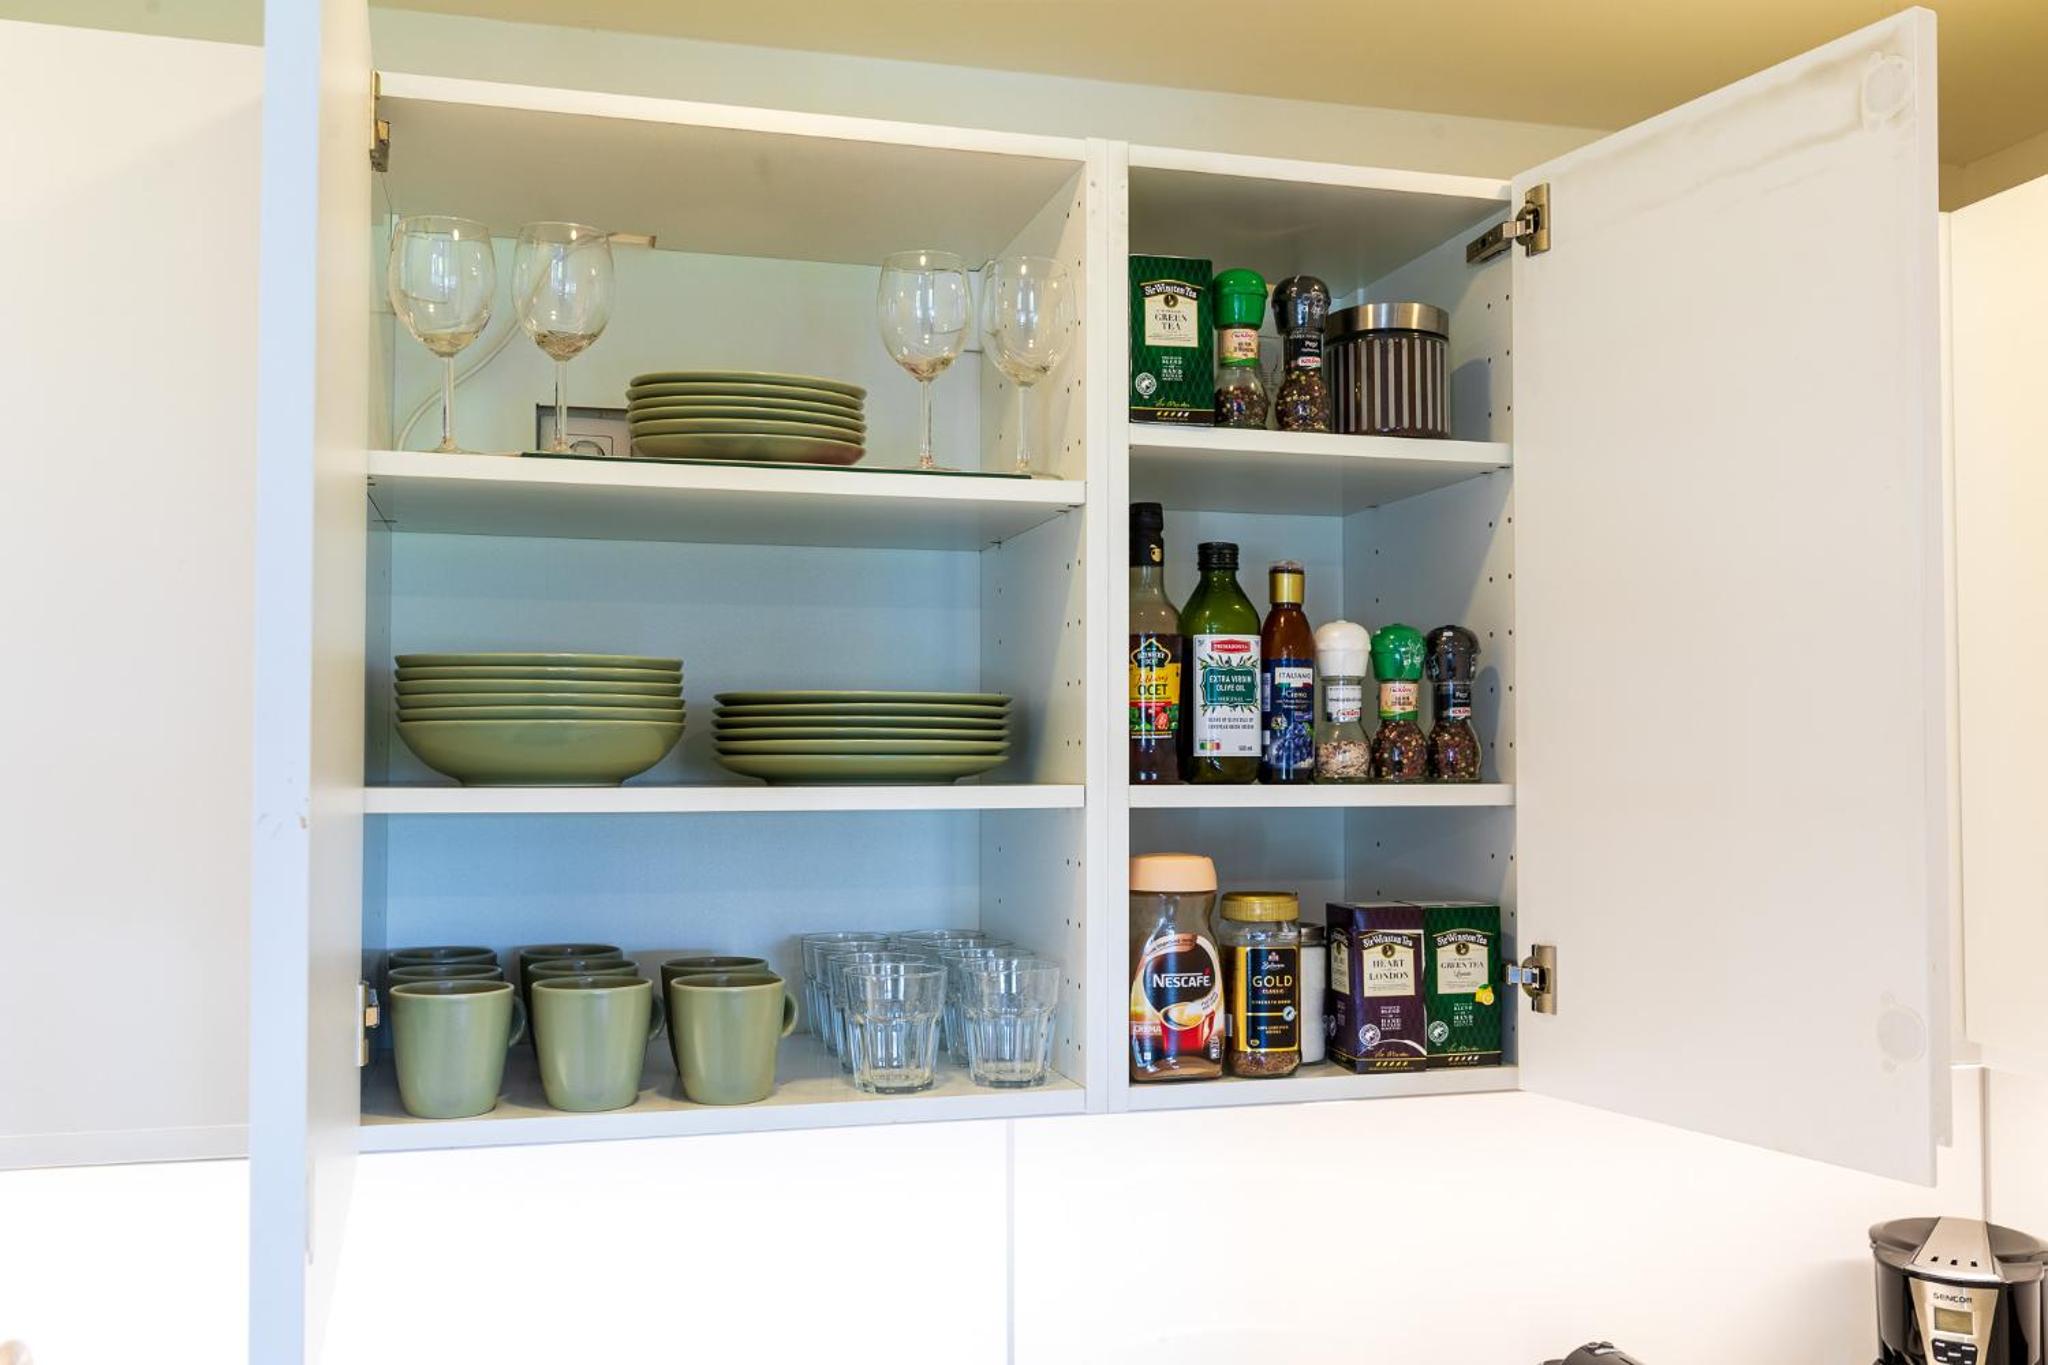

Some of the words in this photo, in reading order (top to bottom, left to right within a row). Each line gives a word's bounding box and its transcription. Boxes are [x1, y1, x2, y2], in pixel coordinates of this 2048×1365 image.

[1155, 313, 1187, 322] GREEN
[1162, 322, 1181, 331] TEA
[1209, 675, 1230, 683] EXTRA
[1231, 675, 1252, 683] VIRGIN
[1137, 684, 1168, 696] OCET
[1216, 684, 1234, 692] OLIVE
[1236, 684, 1246, 692] OIL
[1373, 935, 1402, 944] Winston
[1402, 936, 1413, 946] Tea
[1446, 933, 1476, 942] Winston
[1476, 935, 1488, 944] Tea
[1373, 959, 1405, 968] HEART
[1369, 971, 1409, 981] LONDON
[1252, 975, 1293, 988] GOLD
[1933, 1292, 1972, 1303] SENCOR
